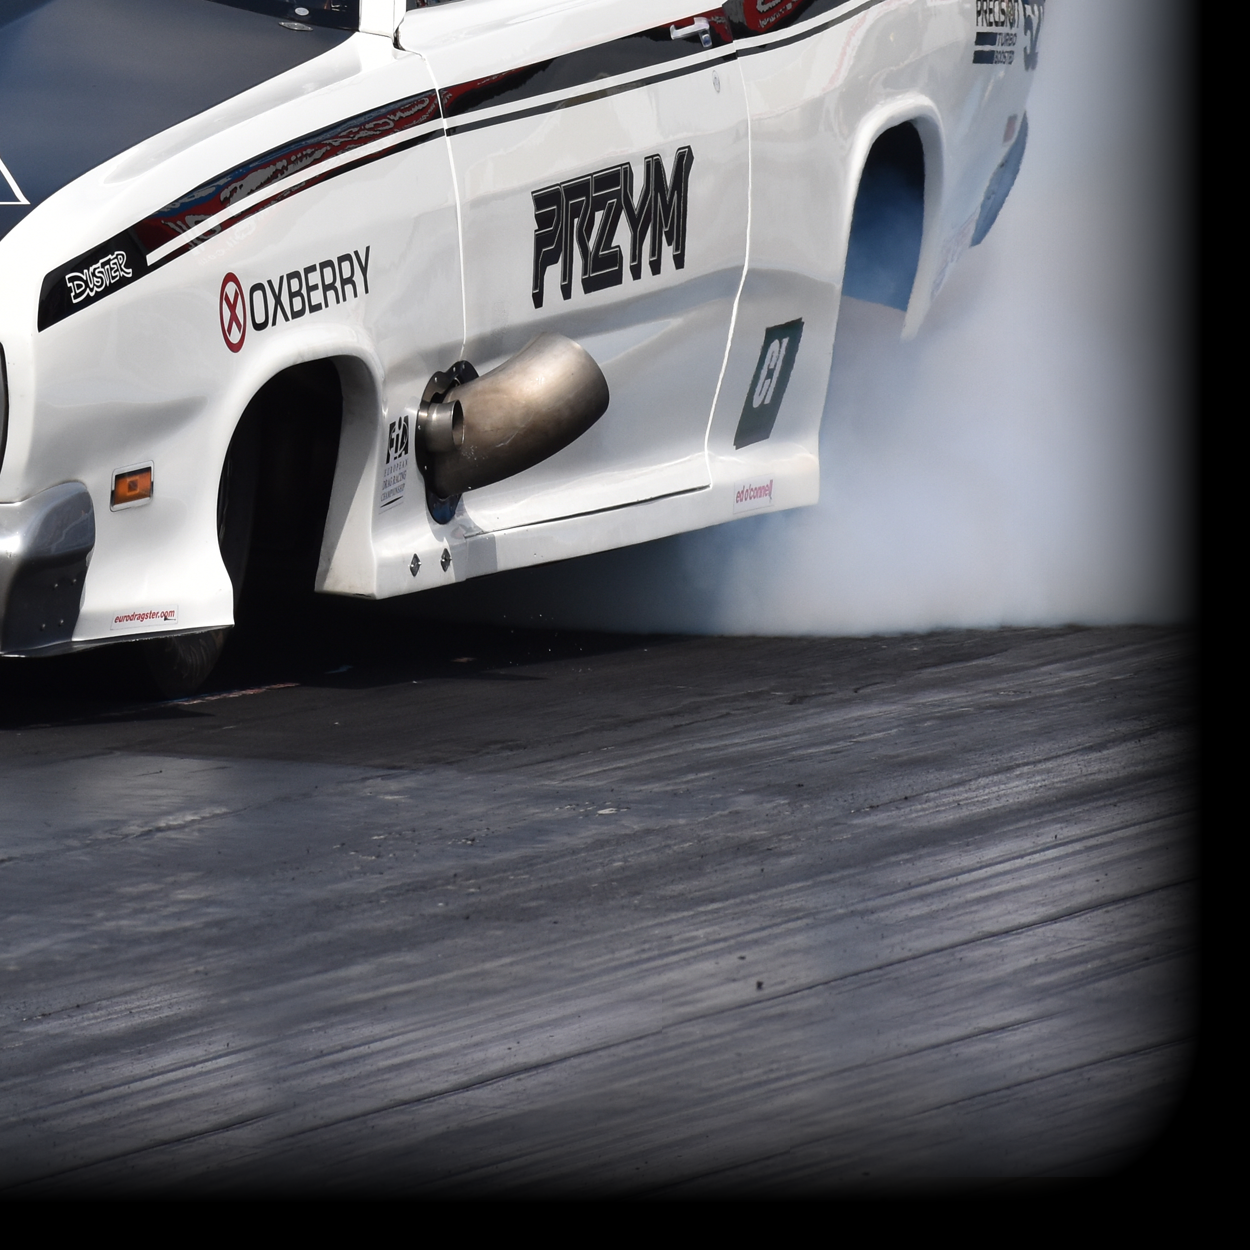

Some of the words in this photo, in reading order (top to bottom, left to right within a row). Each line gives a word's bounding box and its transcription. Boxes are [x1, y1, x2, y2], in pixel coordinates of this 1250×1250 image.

[531, 144, 695, 310] PRZYM
[66, 251, 133, 304] DUSTER
[249, 245, 371, 332] OXBERRY
[114, 610, 175, 624] eurodragster.com
